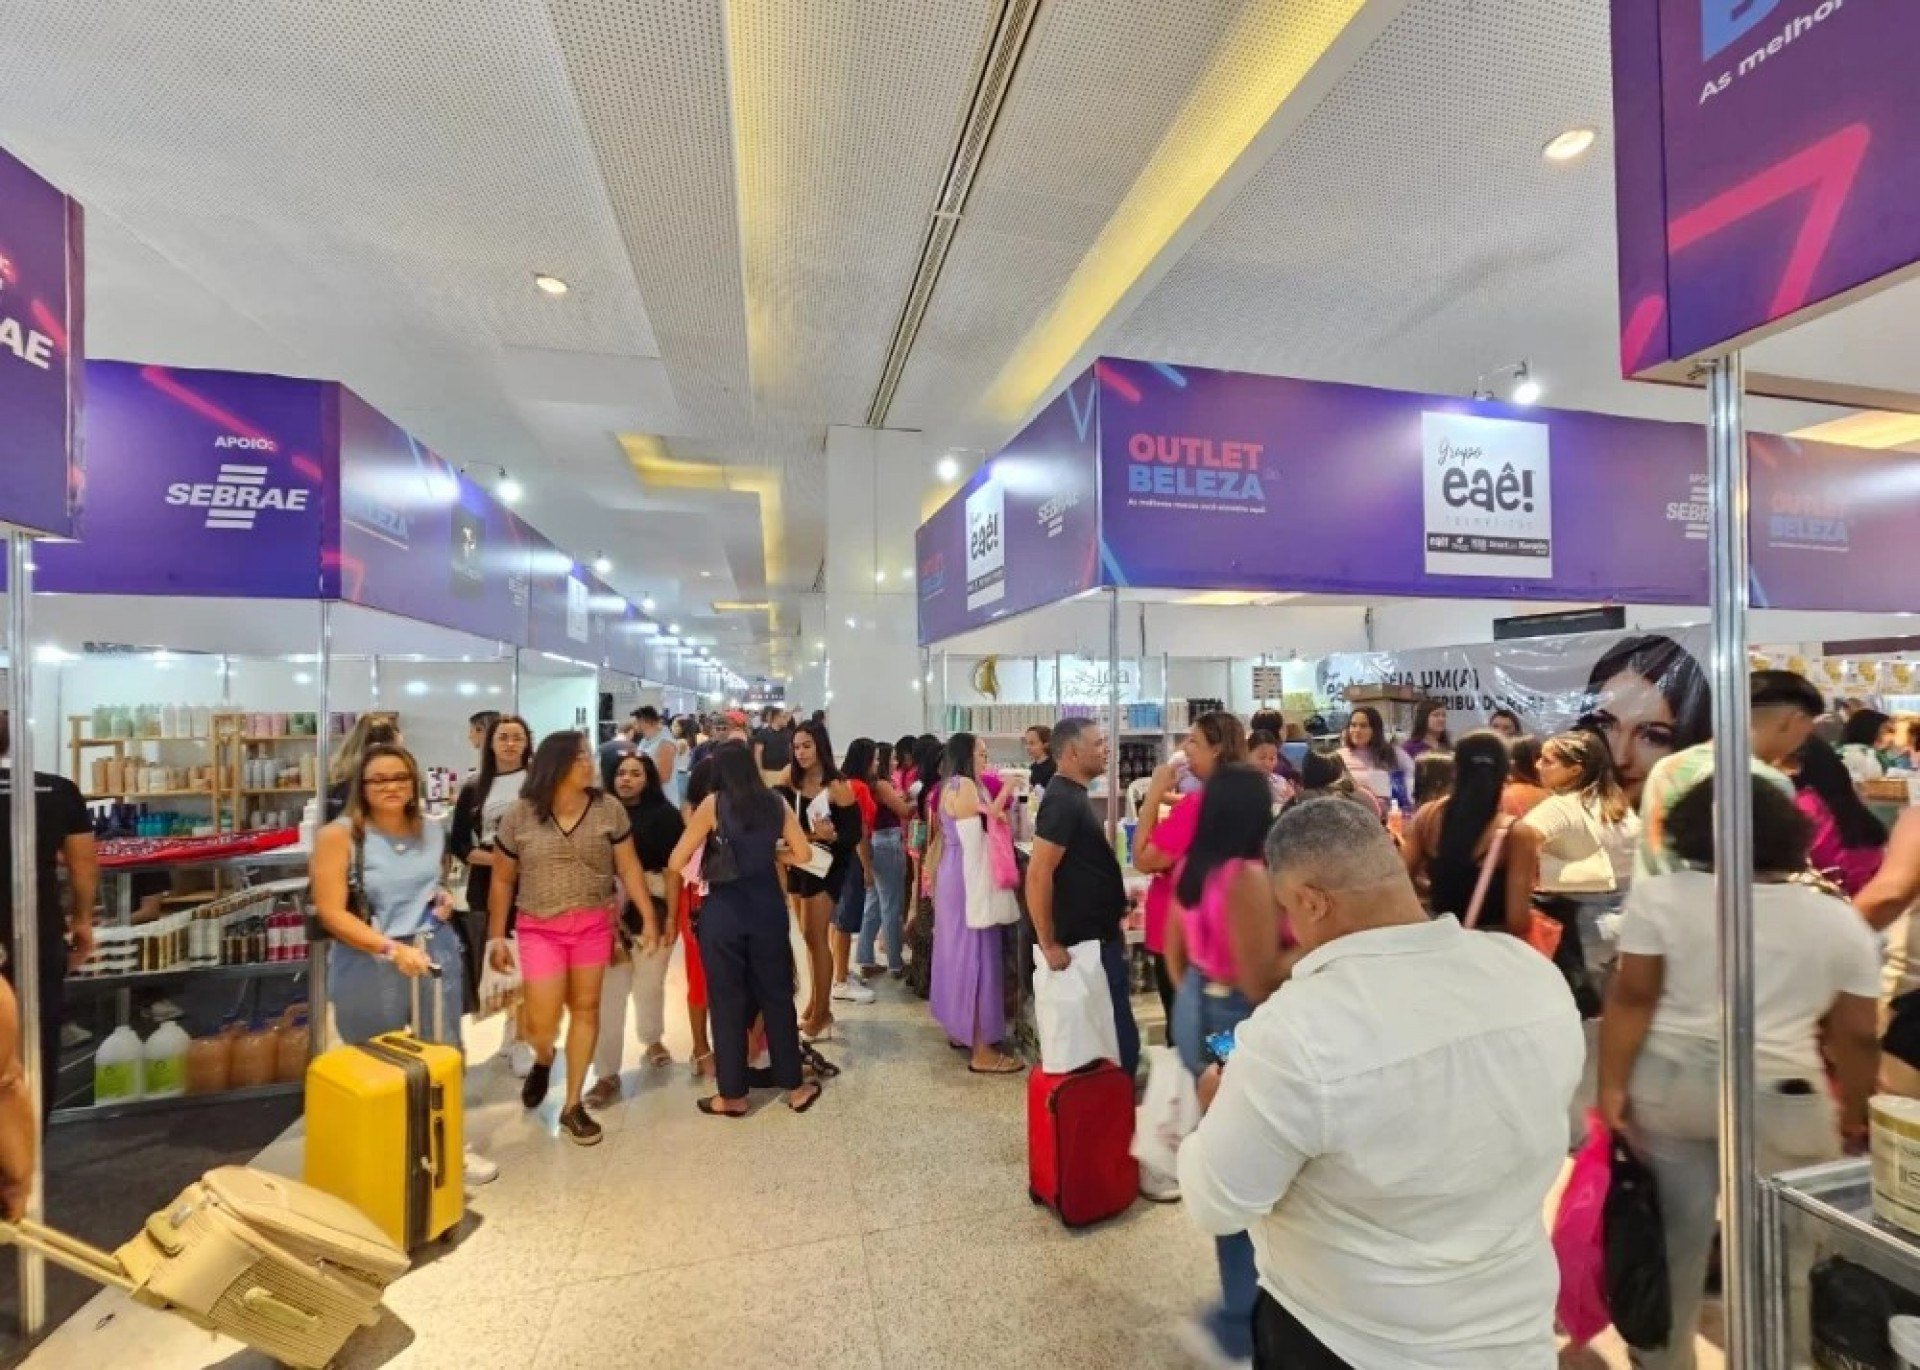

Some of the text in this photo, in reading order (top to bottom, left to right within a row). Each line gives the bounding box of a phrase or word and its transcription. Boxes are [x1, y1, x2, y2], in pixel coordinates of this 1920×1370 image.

[1699, 70, 1733, 105] As
[215, 434, 275, 451] APOIO:
[1129, 433, 1264, 471] OUTLET
[164, 482, 310, 512] SEBRAE
[1128, 463, 1266, 501] BELEZA
[1443, 461, 1535, 514] eaê!
